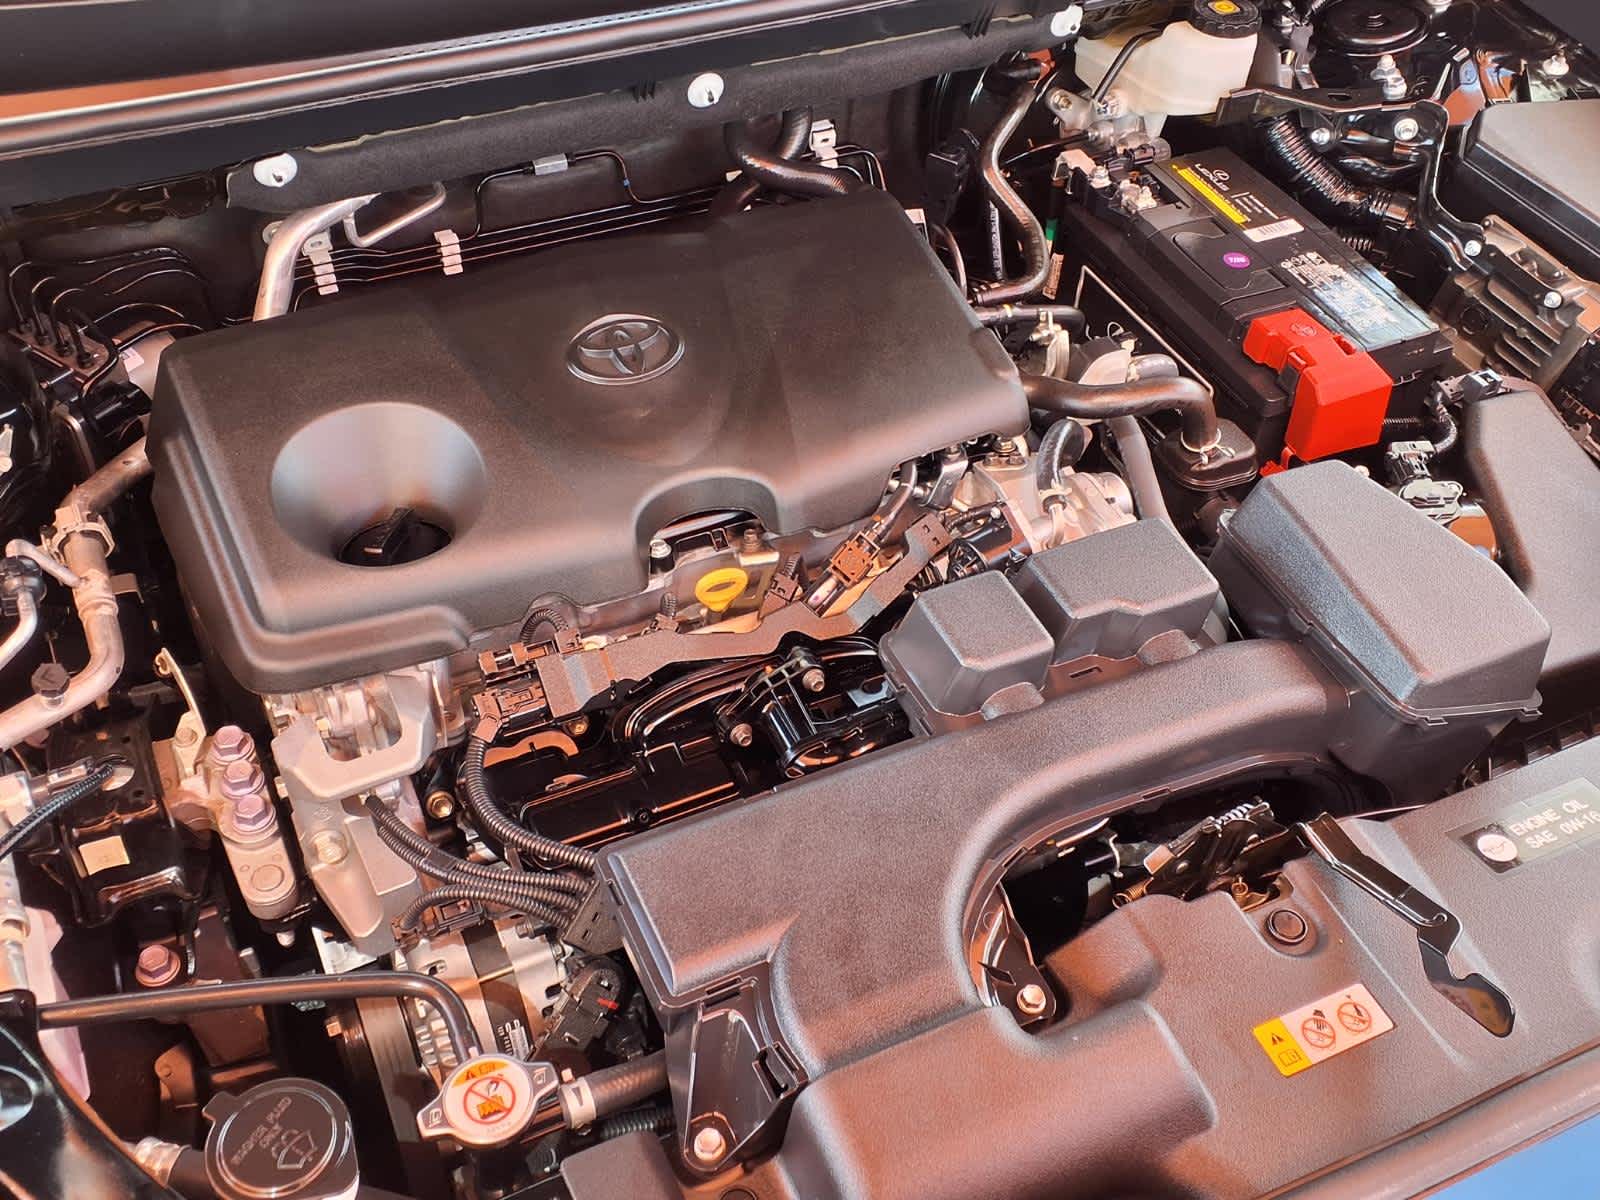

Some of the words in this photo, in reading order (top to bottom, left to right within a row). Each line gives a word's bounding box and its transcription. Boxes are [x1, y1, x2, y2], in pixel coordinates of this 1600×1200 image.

[1194, 163, 1230, 191] LEXUS
[1509, 808, 1561, 836] ENGINE
[1562, 800, 1589, 814] OIL
[1525, 830, 1557, 848] SAE
